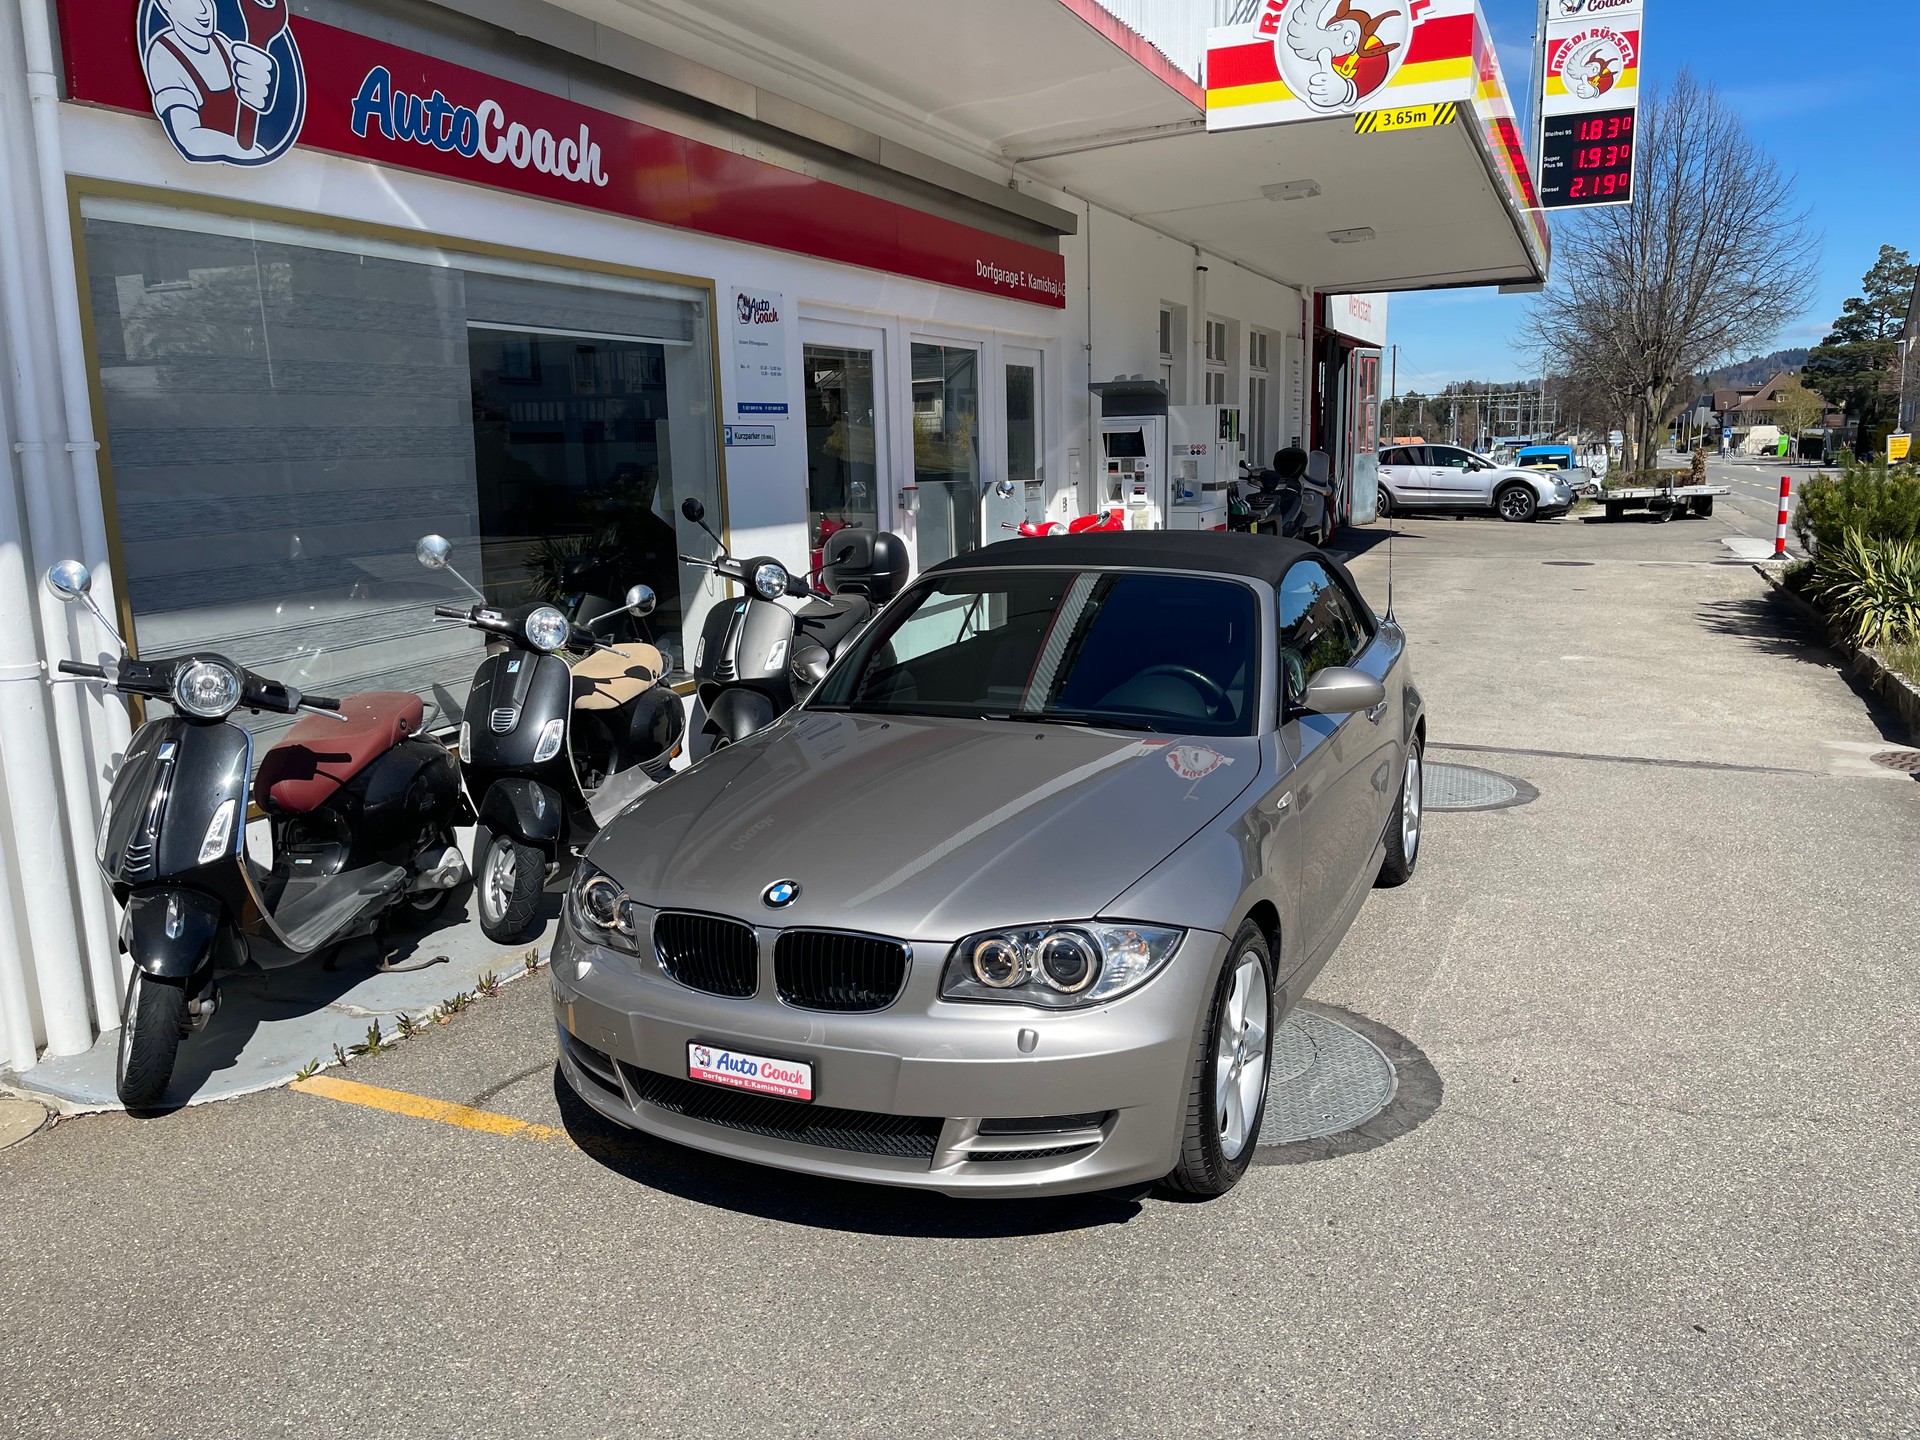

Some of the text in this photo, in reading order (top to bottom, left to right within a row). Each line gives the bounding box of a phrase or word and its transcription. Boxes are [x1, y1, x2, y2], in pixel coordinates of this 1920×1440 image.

[1553, 26, 1632, 69] RUEDI RÜSSEL
[1383, 110, 1427, 126] 3.65m
[976, 259, 1019, 288] Dorfgarage
[1020, 271, 1027, 287] E.
[1028, 273, 1057, 298] Kamishaj
[751, 297, 770, 314] Auto
[753, 307, 779, 325] Coach
[734, 432, 761, 441] Kurzparker
[716, 1052, 805, 1085] Auto Coach
[702, 1071, 743, 1086] Dorfgarage
[787, 1088, 798, 1096] AG
